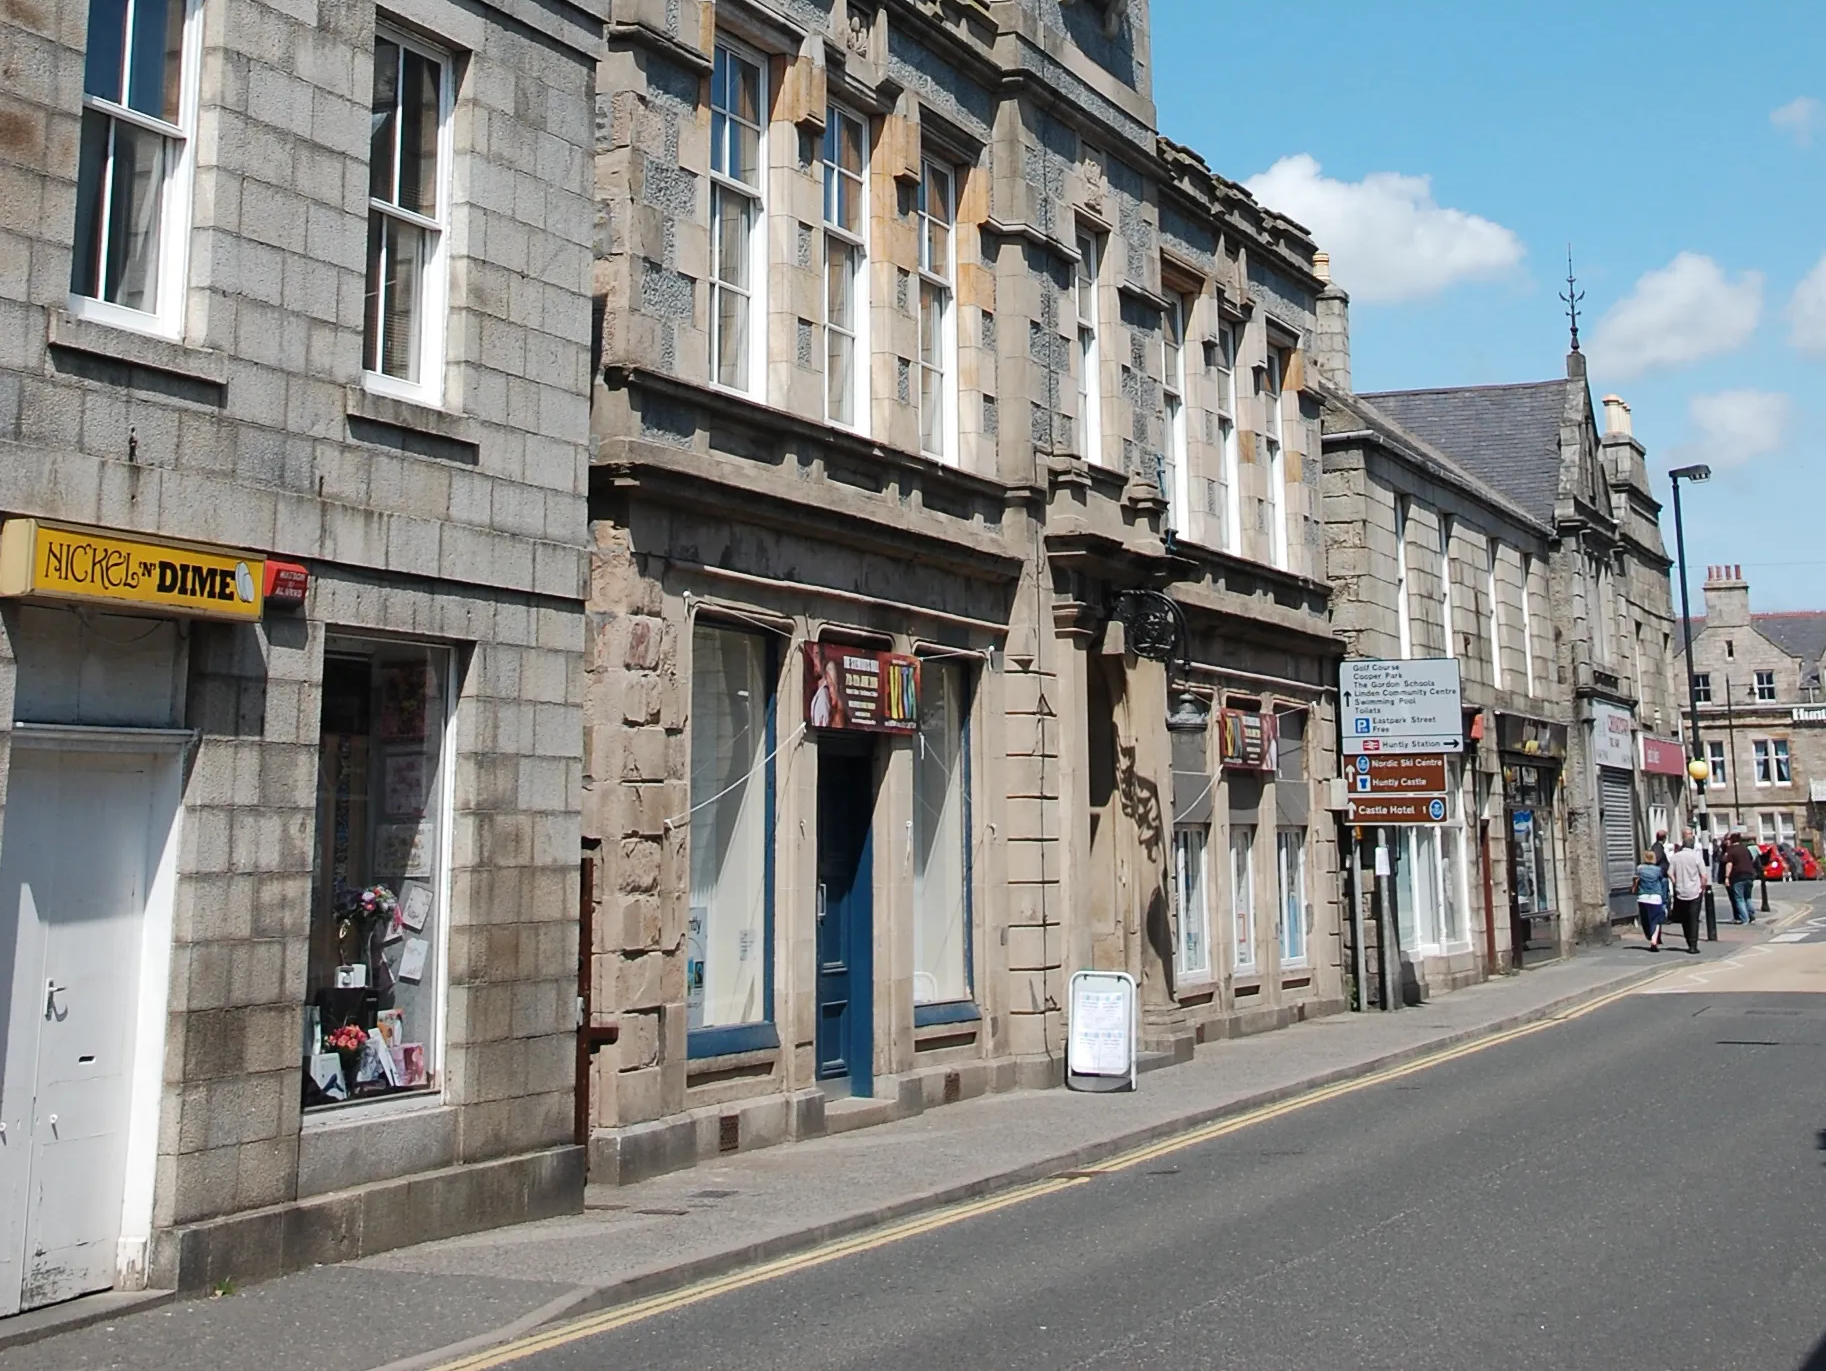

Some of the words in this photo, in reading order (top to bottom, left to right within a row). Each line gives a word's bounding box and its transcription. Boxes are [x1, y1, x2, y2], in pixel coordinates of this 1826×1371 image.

[44, 541, 140, 590] NICKEL
[157, 560, 236, 602] DIME
[1353, 664, 1369, 672] Golf
[1353, 673, 1382, 681] Cooper
[1354, 689, 1380, 697] Linden
[1383, 689, 1427, 697] Community
[1355, 698, 1395, 706] Swimming
[1399, 697, 1416, 705] Pool
[1372, 717, 1407, 725] Eastpark
[1382, 741, 1409, 749] Huntly
[1411, 739, 1441, 747] Station
[1371, 759, 1398, 767] Nordic
[1416, 758, 1442, 766] Centre
[1372, 778, 1399, 787] Huntly
[1401, 778, 1427, 786] Castle
[1358, 806, 1387, 815] Castle
[1390, 805, 1415, 814] Hotel
